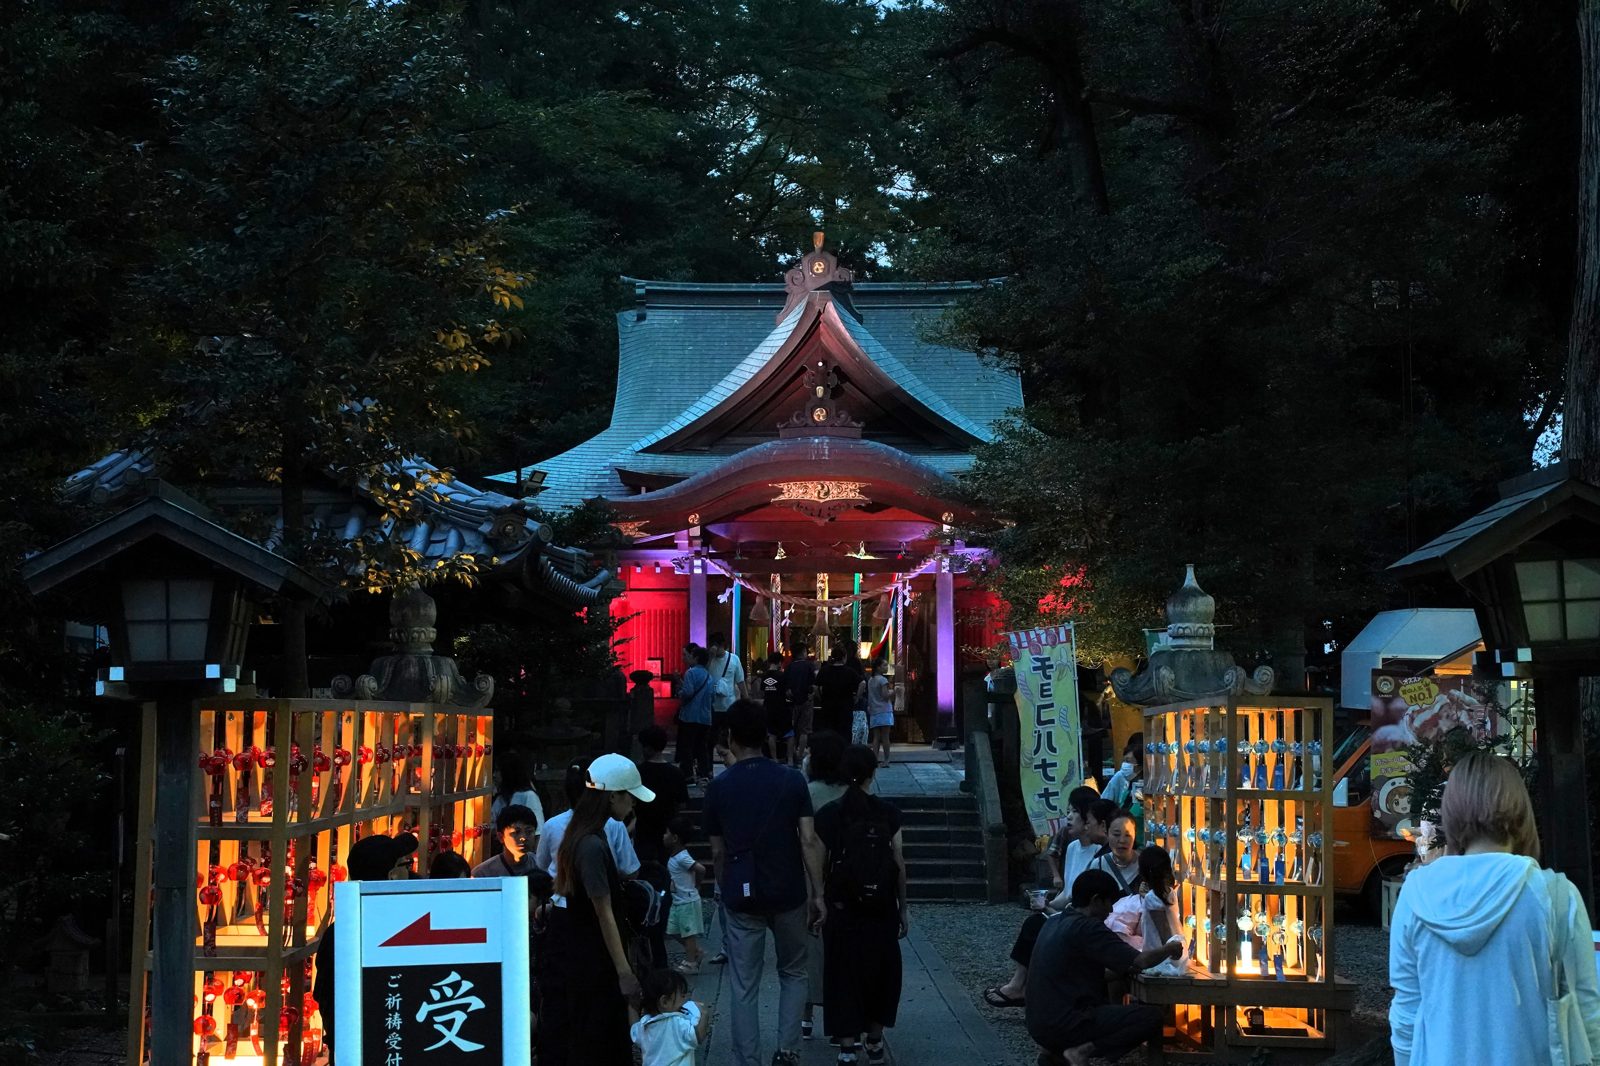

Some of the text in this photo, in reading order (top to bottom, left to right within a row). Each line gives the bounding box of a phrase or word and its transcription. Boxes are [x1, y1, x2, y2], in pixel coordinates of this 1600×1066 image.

[1409, 686, 1433, 703] NO.1
[384, 973, 403, 1066] ご祈祷受付
[415, 970, 486, 1053] 受
